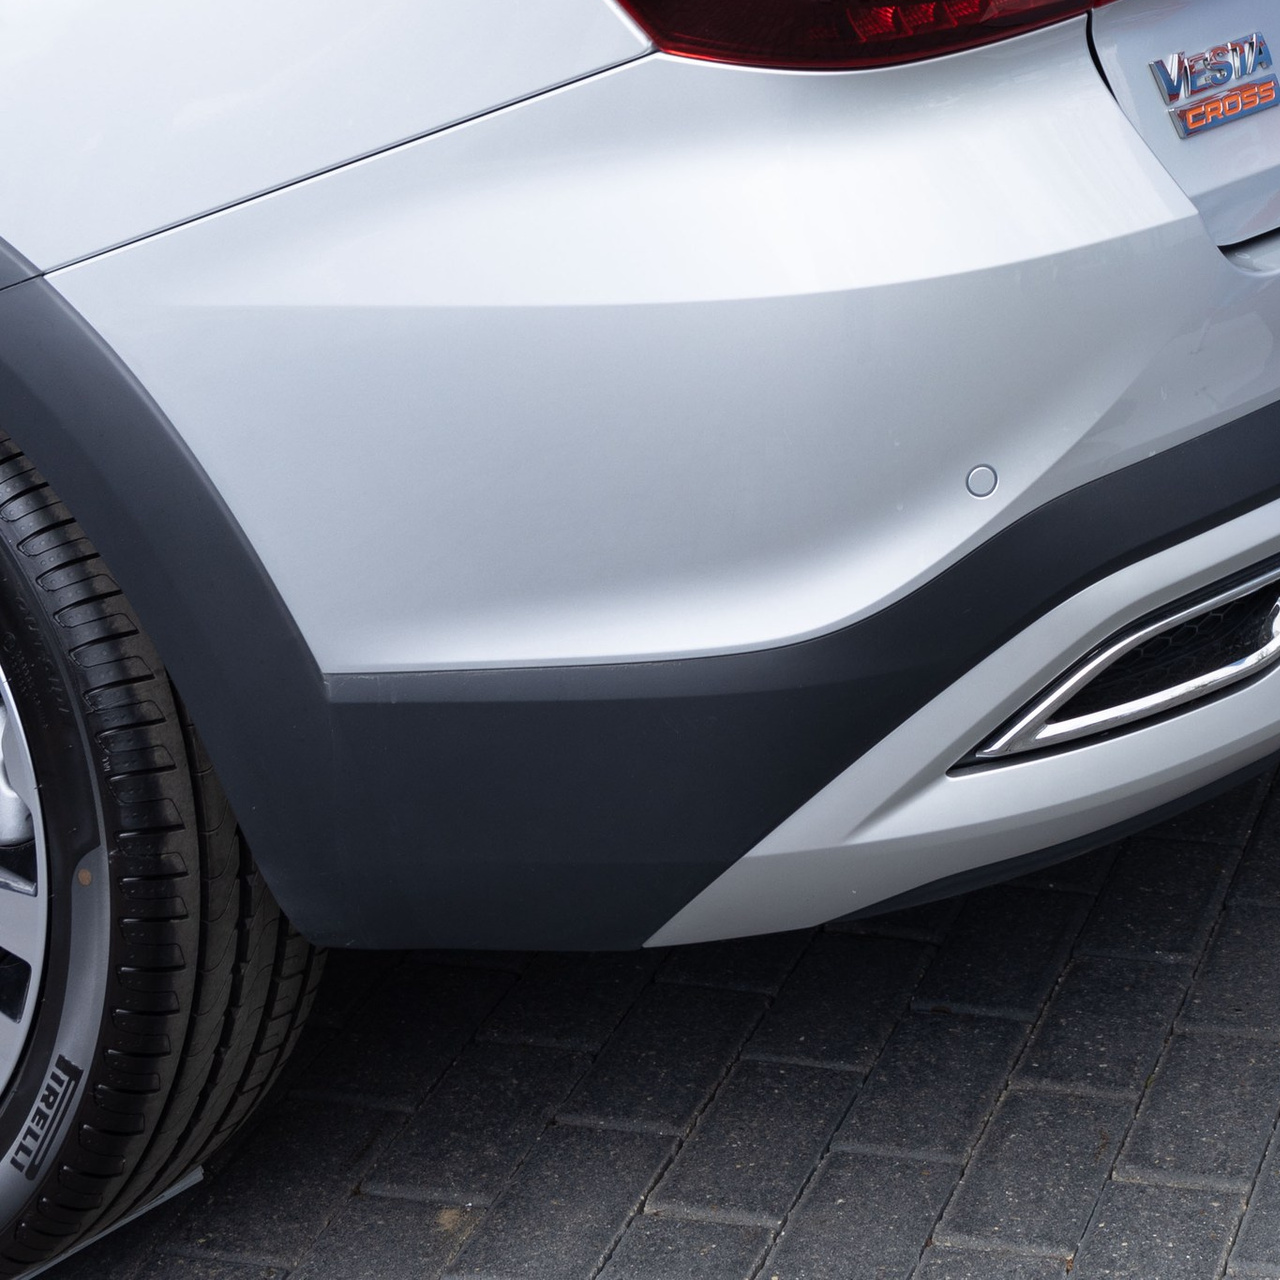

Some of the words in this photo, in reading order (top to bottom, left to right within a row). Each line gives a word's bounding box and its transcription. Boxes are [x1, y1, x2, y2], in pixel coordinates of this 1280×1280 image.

[1149, 31, 1273, 106] VESTA
[1185, 80, 1276, 130] CROSS
[9, 1053, 84, 1181] PIRELLI
